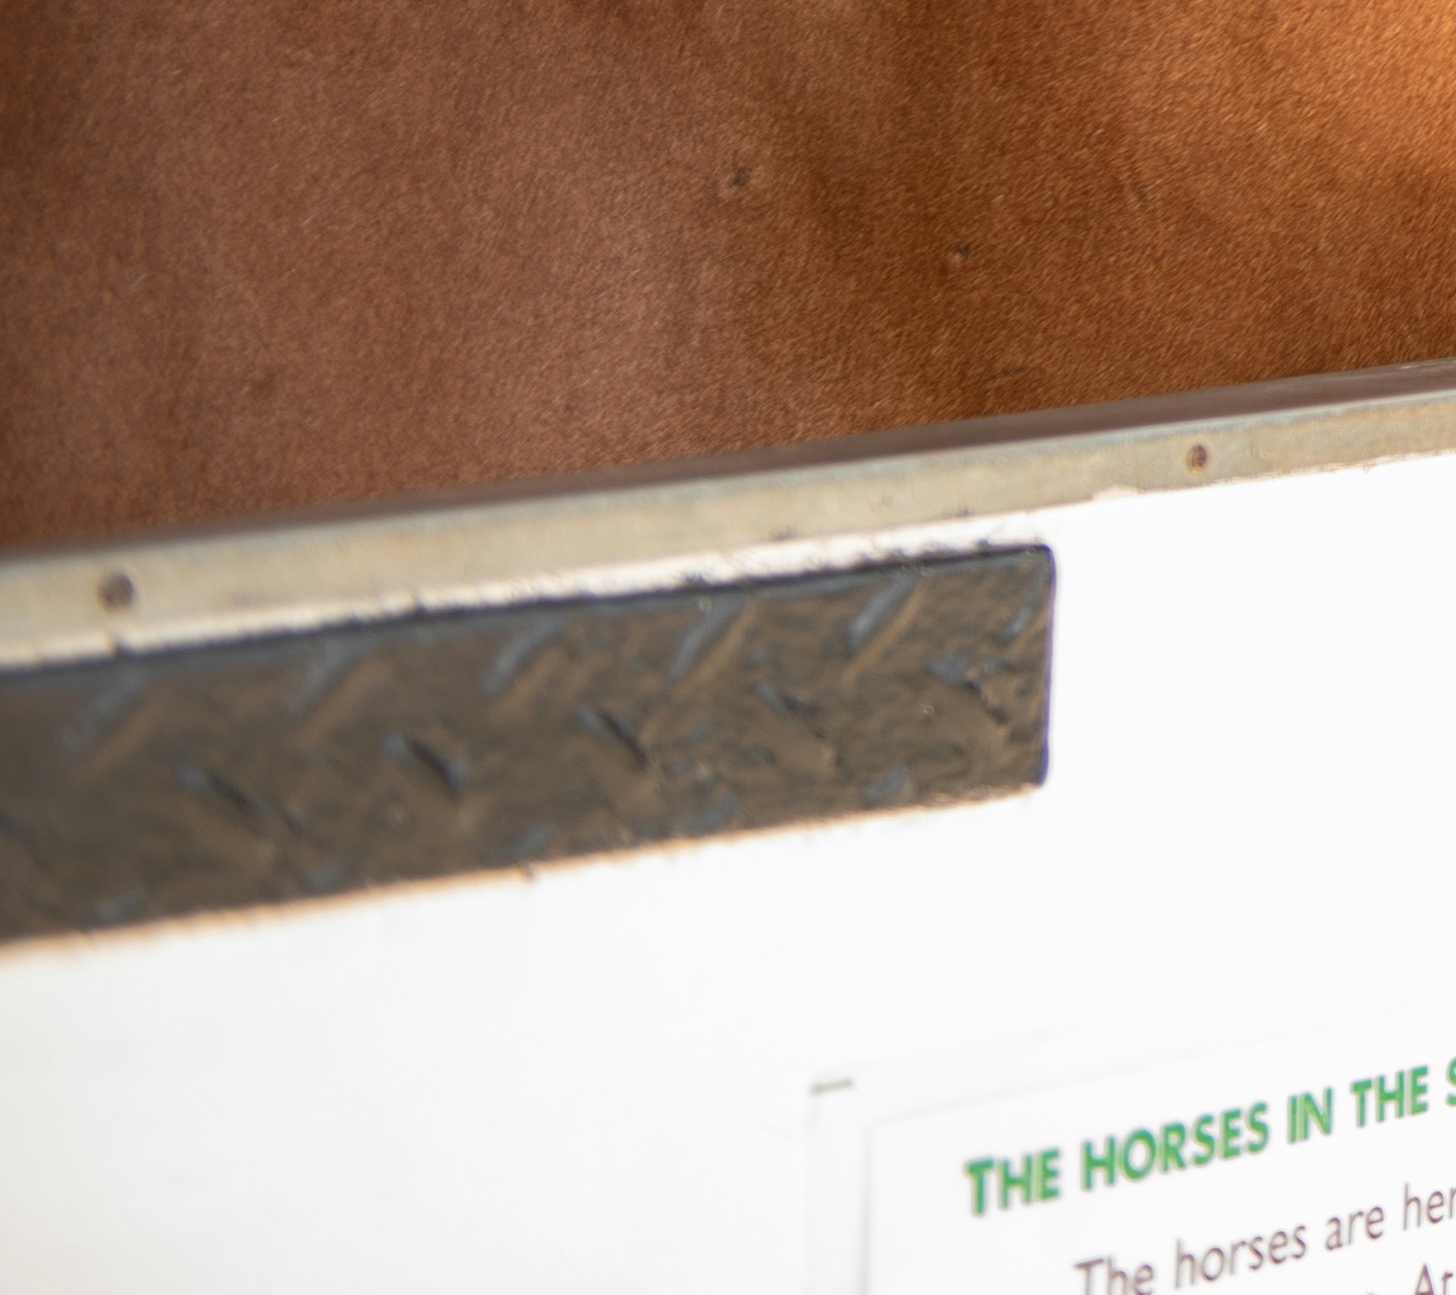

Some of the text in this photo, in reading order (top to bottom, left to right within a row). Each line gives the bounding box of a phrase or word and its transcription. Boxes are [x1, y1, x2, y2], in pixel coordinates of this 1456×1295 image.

[963, 1146, 1064, 1218] THE
[1080, 1100, 1272, 1194] HORSES
[1286, 1086, 1335, 1146] IN
[1349, 1064, 1431, 1129] THE
[1073, 1255, 1156, 1295] The
[1174, 1225, 1307, 1291] horses
[1325, 1205, 1384, 1252] are
